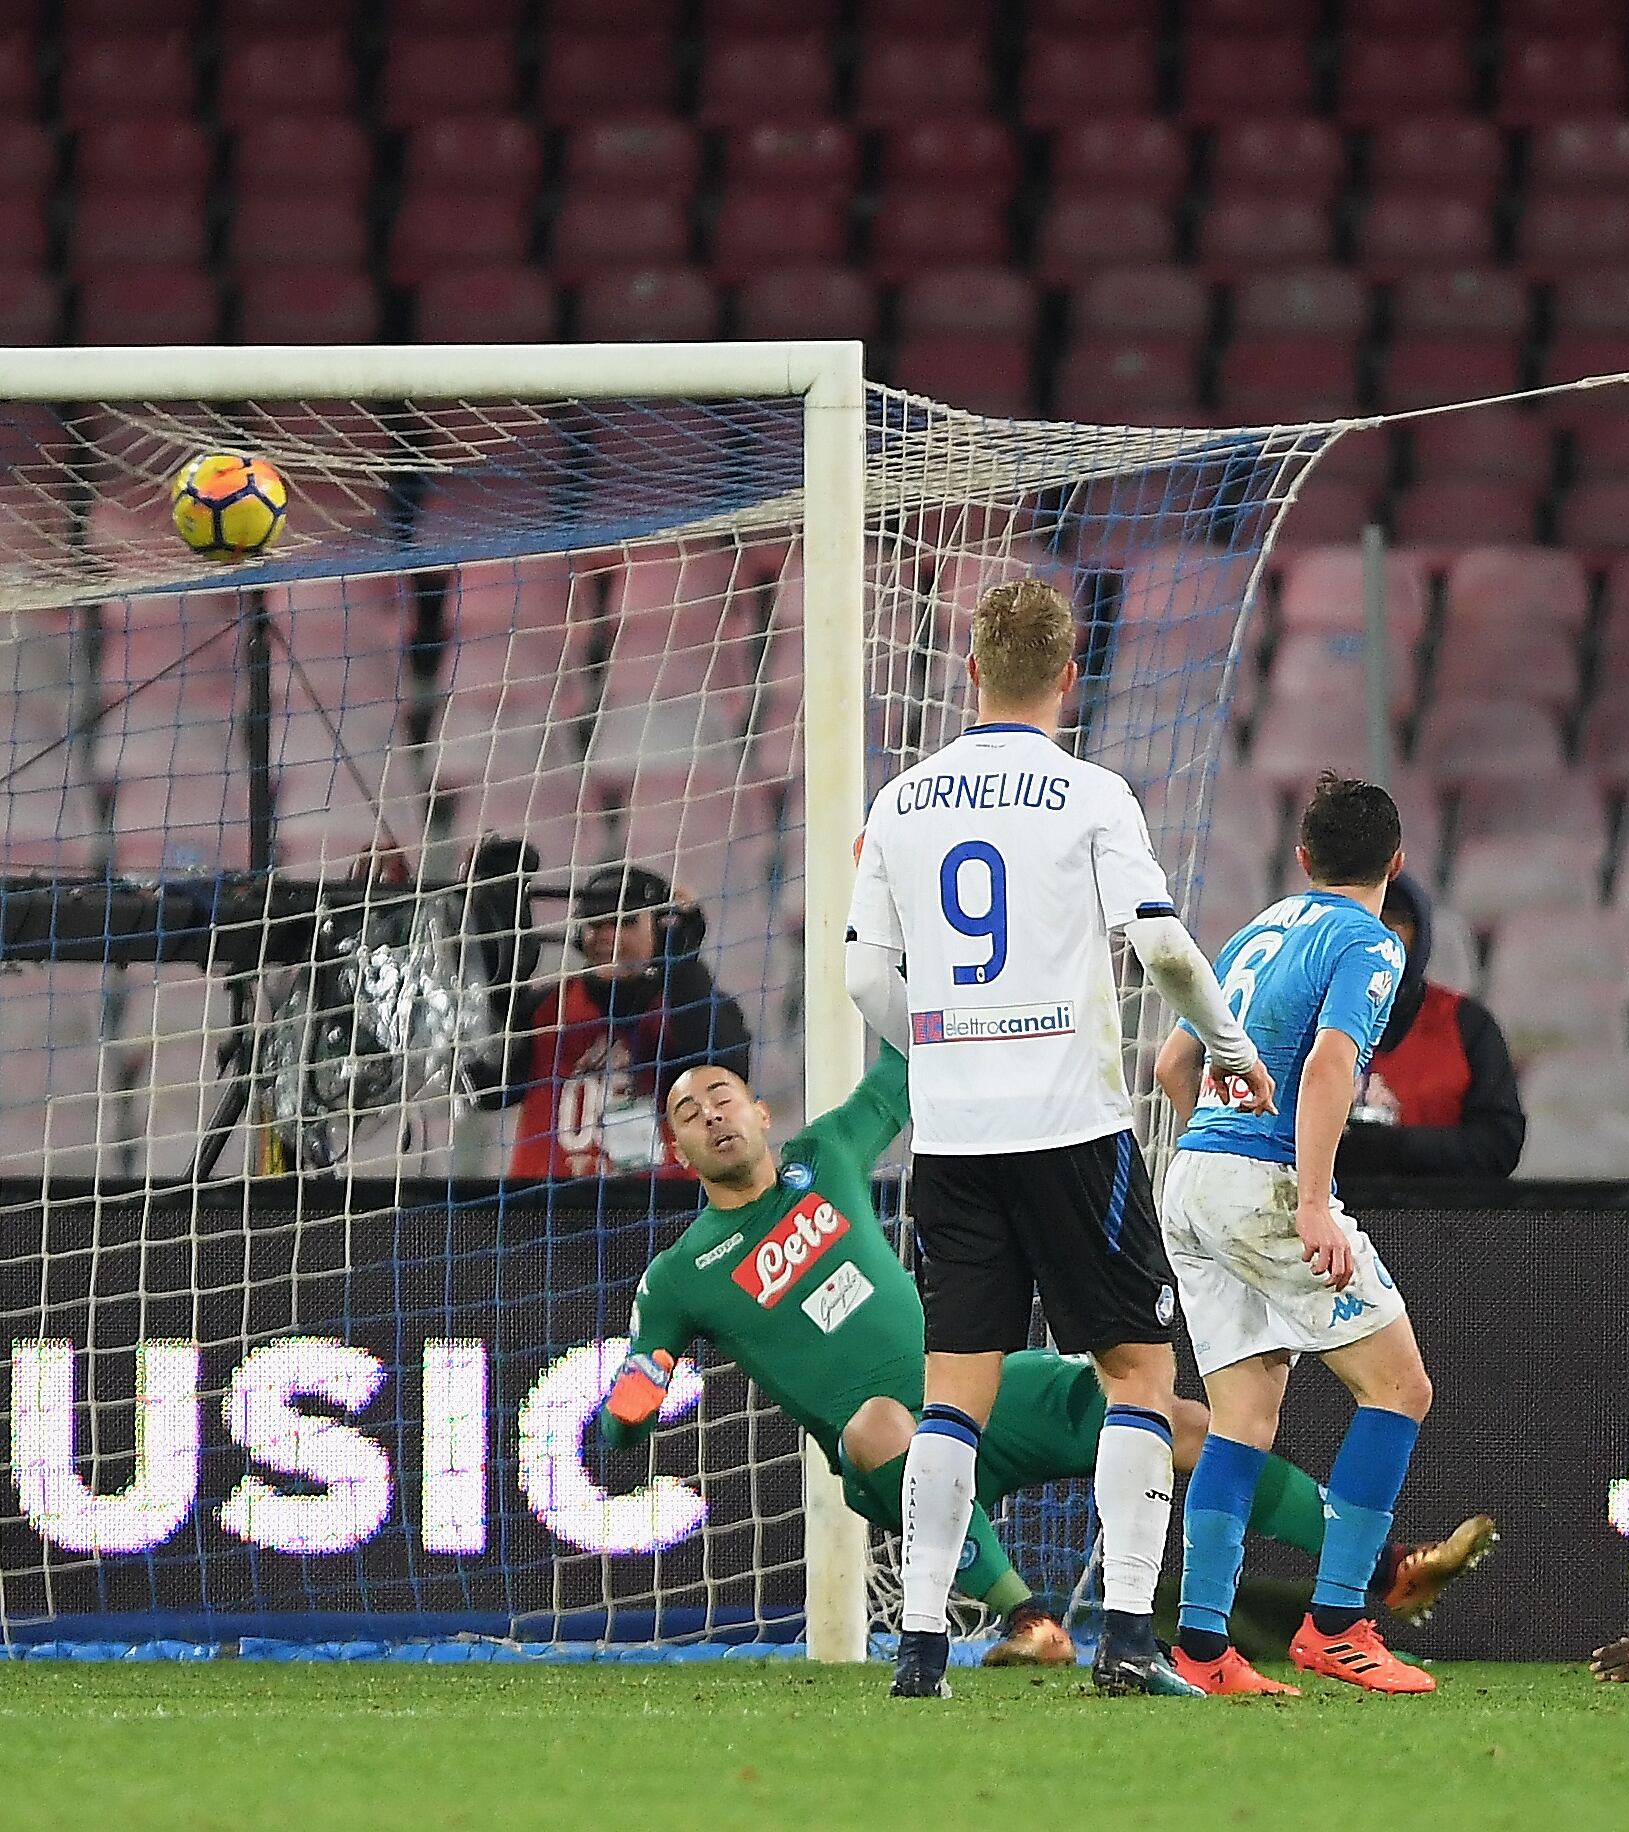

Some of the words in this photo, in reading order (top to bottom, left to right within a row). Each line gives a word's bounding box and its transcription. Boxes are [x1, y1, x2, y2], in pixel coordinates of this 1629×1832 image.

[897, 773, 1069, 815] CORNELIUS
[940, 840, 1008, 985] 9
[946, 1006, 1070, 1036] elettrocanali
[756, 1202, 838, 1304] Lete
[11, 1337, 708, 1554] USIC
[905, 1476, 917, 1566] ATALANTA
